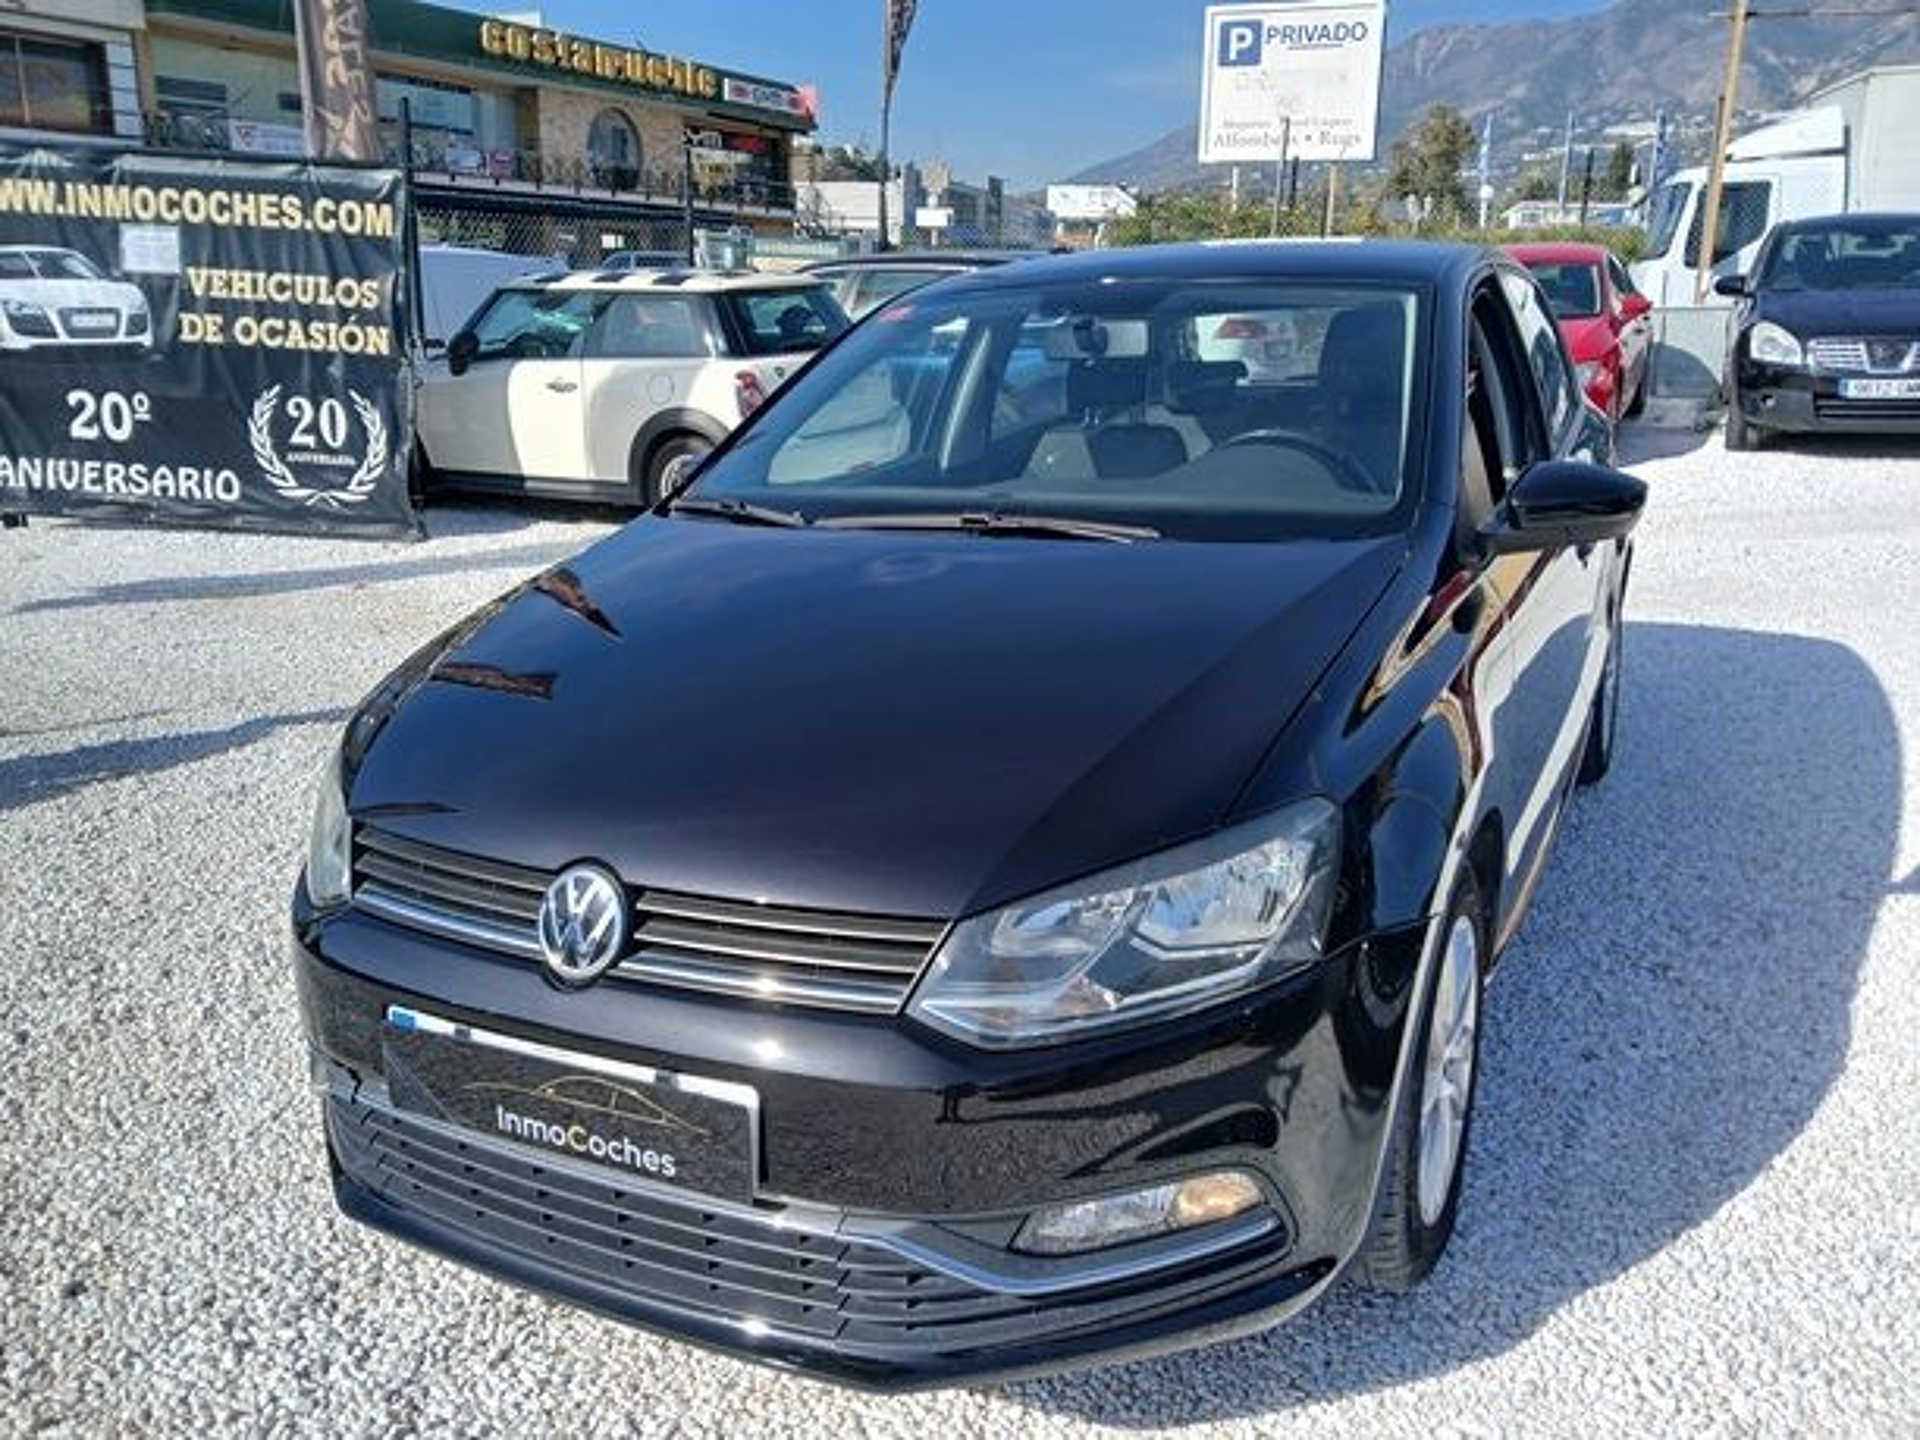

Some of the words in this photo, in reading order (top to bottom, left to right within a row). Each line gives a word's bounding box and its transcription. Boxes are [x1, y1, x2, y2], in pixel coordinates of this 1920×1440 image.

[1265, 21, 1369, 45] PRIVADO
[186, 266, 380, 309] VEHICULOS
[179, 313, 224, 344] DE
[233, 314, 391, 355] OCASIÓN
[285, 395, 347, 450] 20
[496, 1104, 677, 1177] InmoCoches
